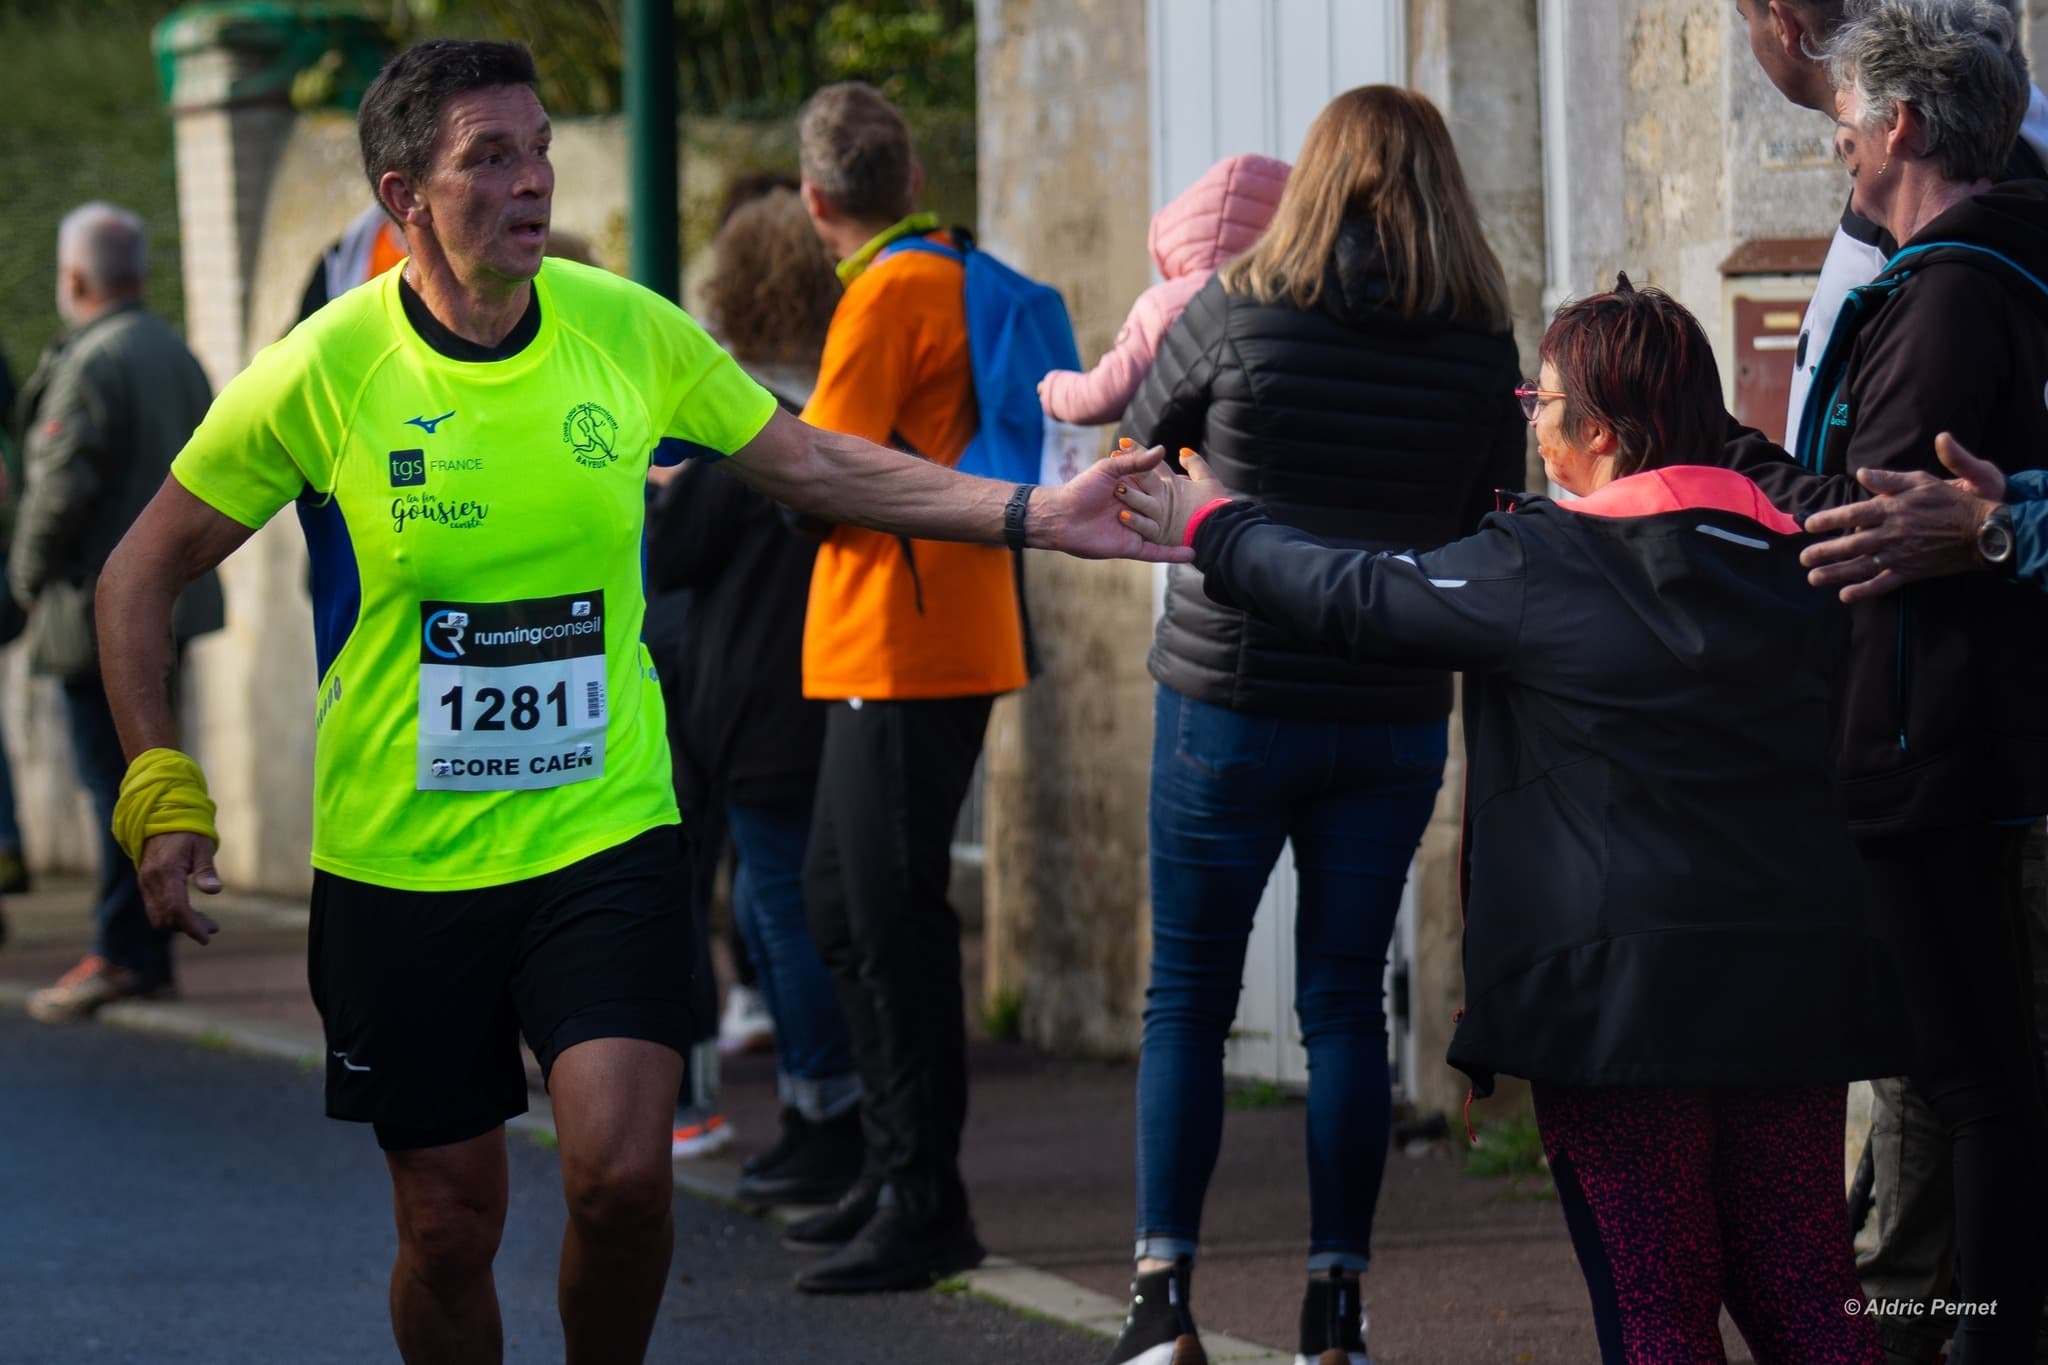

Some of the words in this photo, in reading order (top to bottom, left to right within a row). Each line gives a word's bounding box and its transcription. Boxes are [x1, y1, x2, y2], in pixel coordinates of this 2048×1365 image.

[391, 459, 423, 481] tgs
[430, 458, 484, 472] FRANCE
[391, 498, 489, 533] Gousier
[474, 615, 601, 645] runningconseil
[440, 681, 568, 731] 1281
